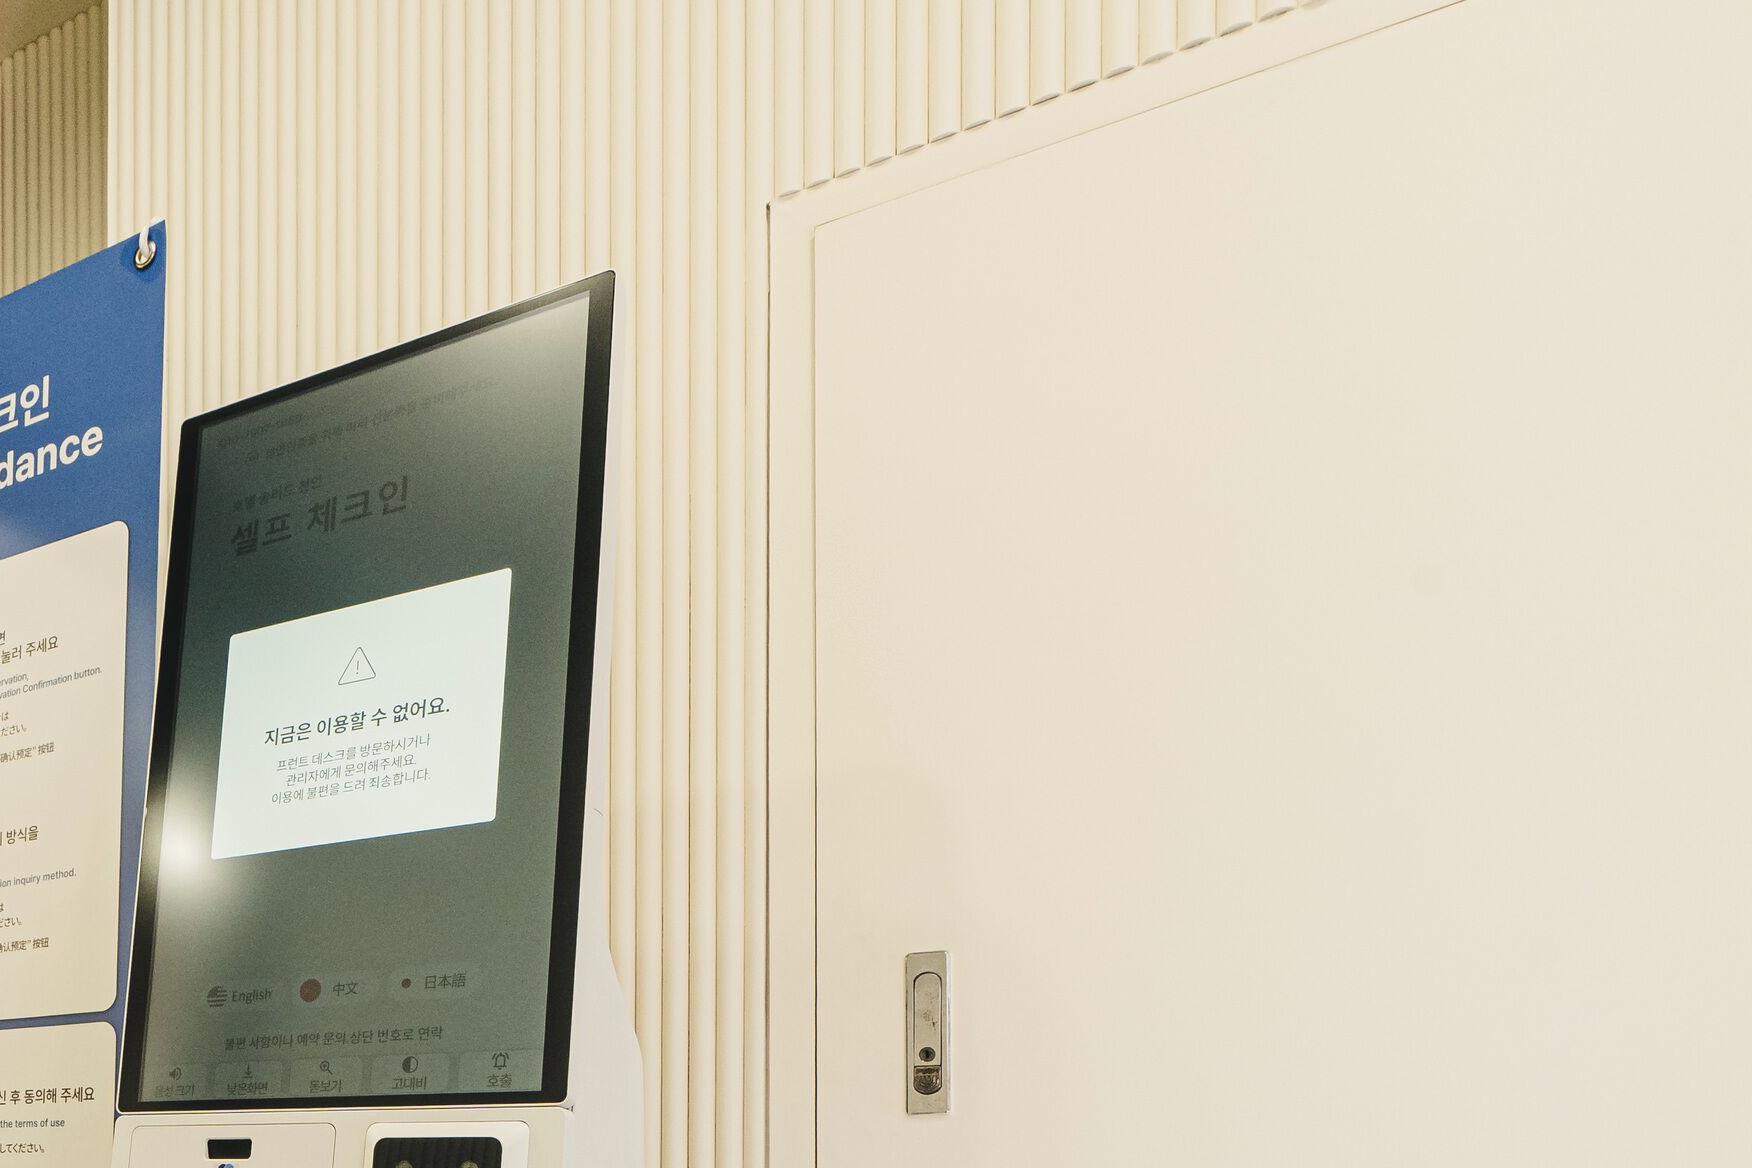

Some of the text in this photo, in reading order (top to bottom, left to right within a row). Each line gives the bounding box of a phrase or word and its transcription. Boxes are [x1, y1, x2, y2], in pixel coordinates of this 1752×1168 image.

[230, 514, 293, 557] 셀프
[307, 475, 410, 534] 체크인
[0, 645, 22, 664] 눌러
[25, 635, 59, 656] 주세요
[263, 696, 451, 748] 지금은 이용할 수 없어요.
[276, 733, 432, 773] 프런트 데스크를 방문하시거나
[285, 753, 417, 787] 관리자에게 문의해주세요.
[271, 768, 432, 805] 이용에 불편을 드려 죄송합니다.
[6, 825, 39, 845] 방식을
[332, 980, 358, 997] 中文
[424, 972, 466, 990] 日本語
[231, 988, 272, 1004] English
[392, 1077, 427, 1091] 고대비
[486, 1072, 513, 1089] 호출
[10, 1091, 21, 1105] 후
[24, 1088, 57, 1104] 동의해
[60, 1086, 95, 1103] 주세요
[0, 1120, 13, 1128] the
[15, 1120, 38, 1128] terms
[40, 1118, 48, 1127] of
[50, 1119, 65, 1127] use
